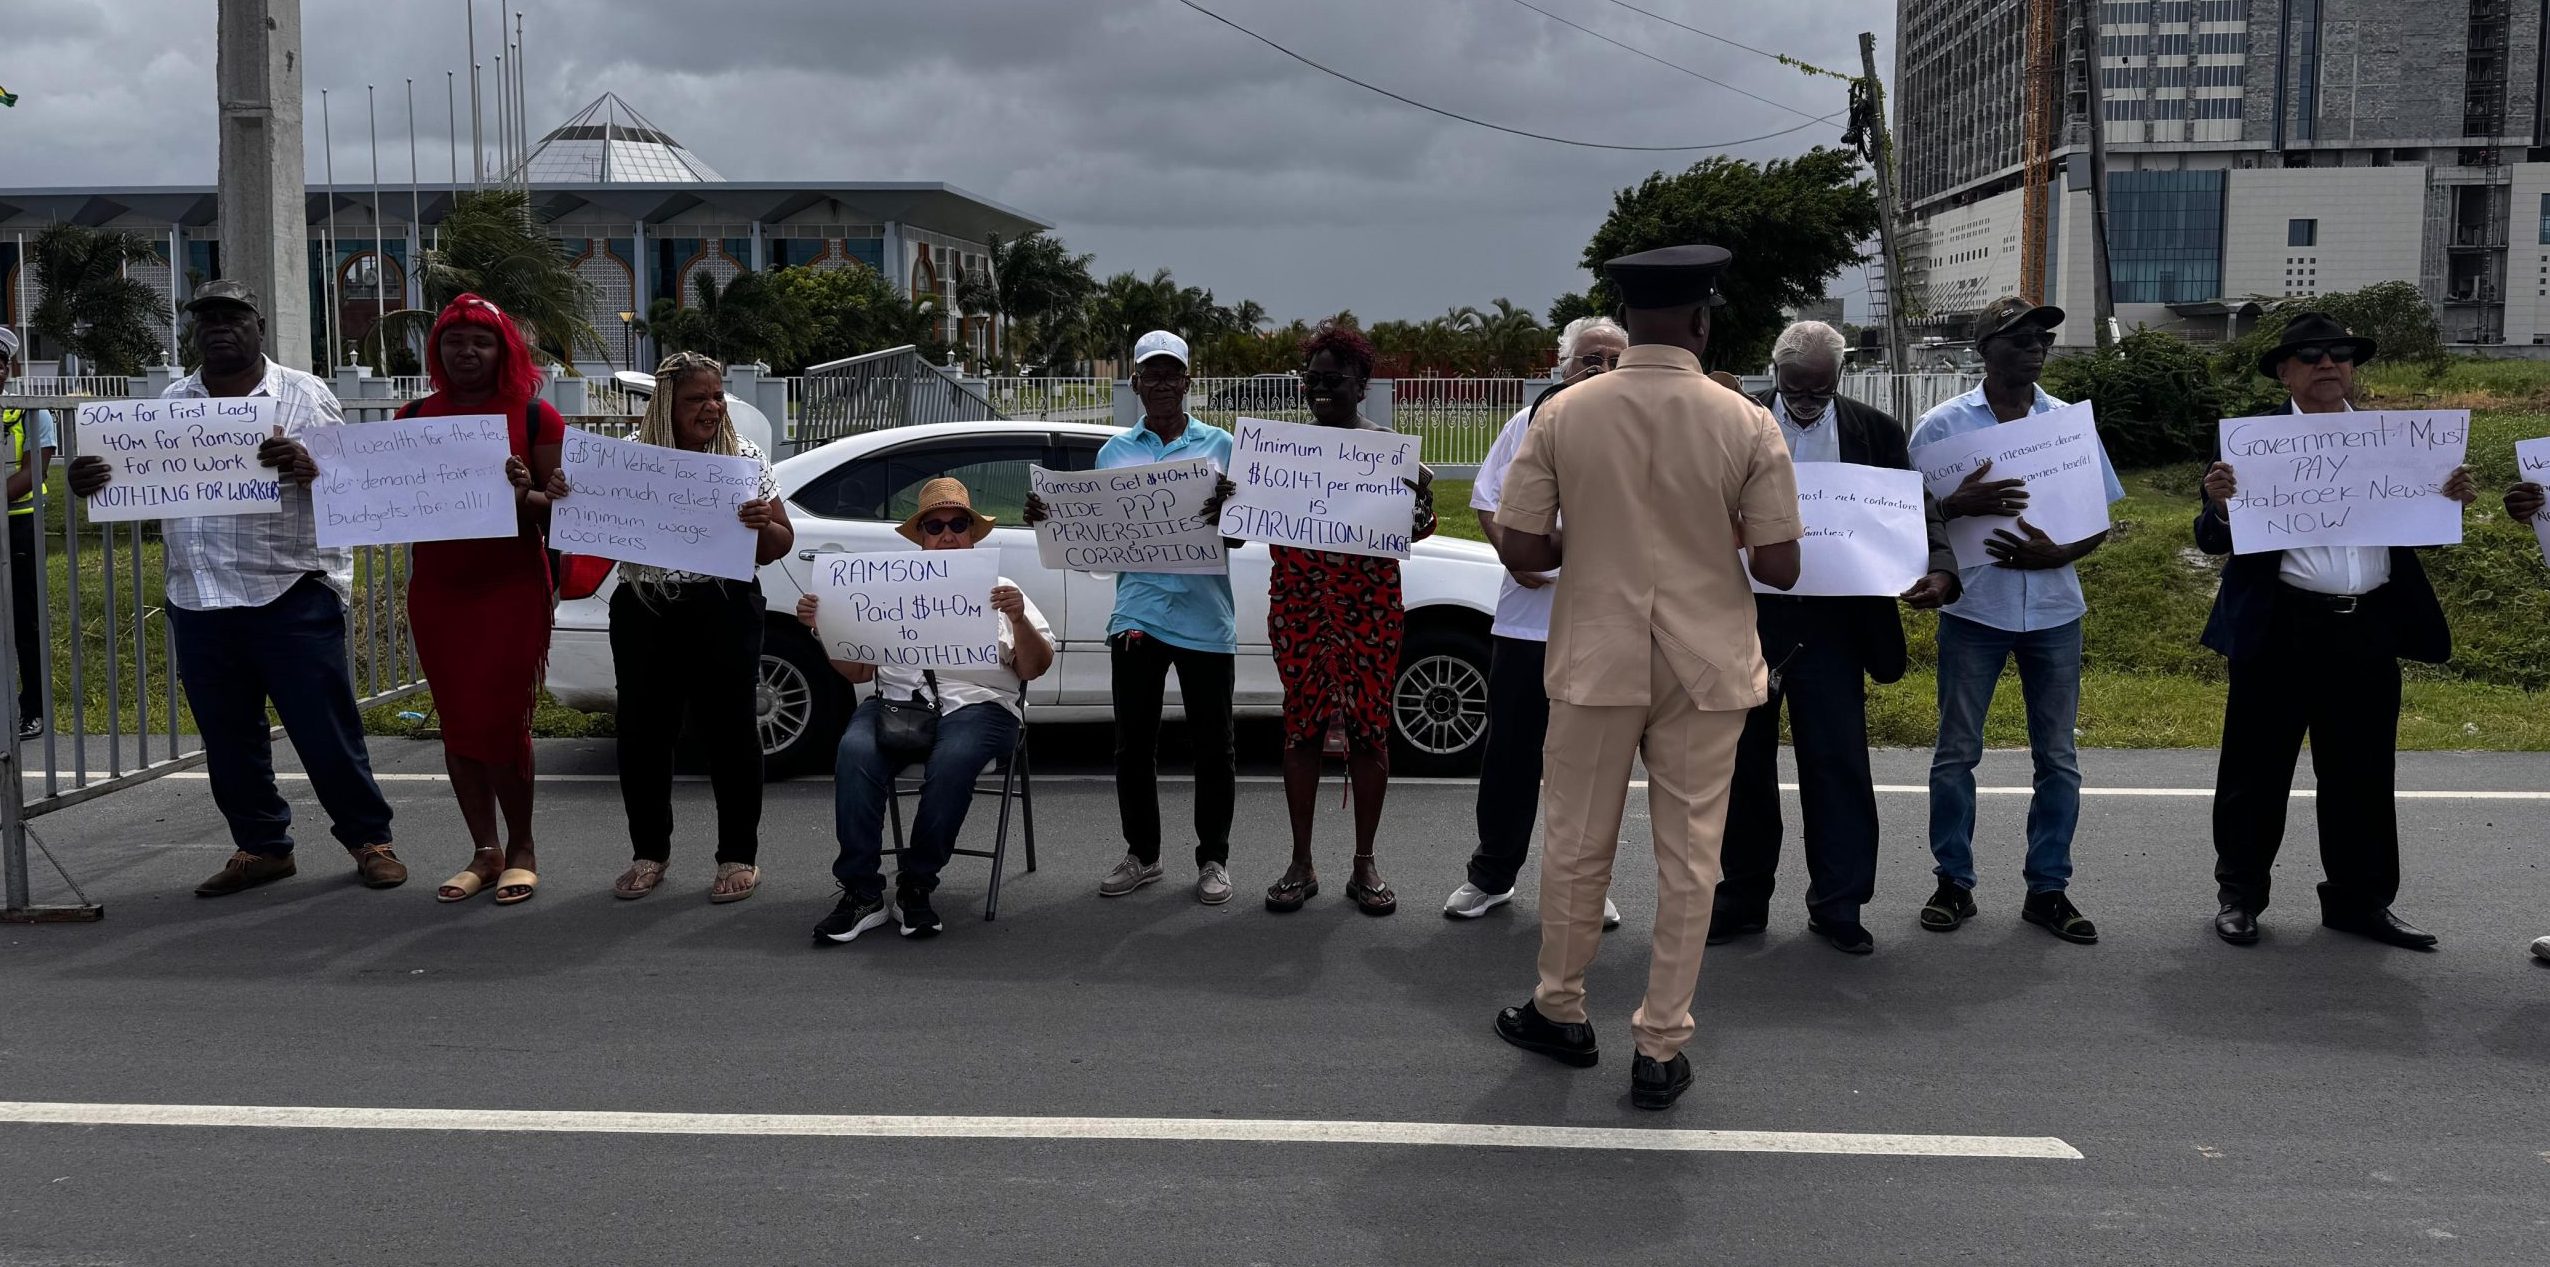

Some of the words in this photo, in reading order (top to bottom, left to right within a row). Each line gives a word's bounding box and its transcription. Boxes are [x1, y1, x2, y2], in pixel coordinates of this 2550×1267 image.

[135, 404, 157, 422] for
[169, 402, 206, 422] First
[217, 401, 258, 423] Lady
[154, 430, 182, 450] for
[187, 424, 265, 450] Ramson
[312, 431, 346, 461] Oil
[354, 428, 418, 455] wealth
[422, 425, 443, 447] for
[450, 423, 475, 442] the
[1240, 426, 1322, 457] Minimum
[1391, 443, 1410, 466] of
[2227, 415, 2388, 456] Government
[2411, 416, 2467, 450] Must
[1999, 440, 2051, 461] measures
[162, 457, 187, 473] no
[622, 450, 667, 475] Vehicle
[669, 457, 697, 481] Tax
[1032, 470, 1101, 495] Ramson
[1110, 473, 1141, 492] Get
[1191, 462, 1209, 479] to
[2289, 454, 2348, 482] PAY
[321, 468, 345, 496] We
[361, 468, 426, 491] demand
[439, 463, 470, 485] fair
[1327, 481, 1350, 499] per
[1356, 477, 1408, 496] month
[2369, 475, 2443, 500] News
[89, 483, 189, 511] NOTHING
[196, 480, 223, 500] FOR
[611, 481, 658, 504] much
[668, 490, 720, 511] relief
[1309, 498, 1327, 515] is
[327, 503, 408, 532] budgets
[414, 490, 442, 516] for
[558, 505, 645, 528] minimum
[657, 521, 711, 545] wage
[1047, 503, 1103, 519] HIDE
[1221, 505, 1363, 545] STARVATION
[2267, 507, 2351, 534] NOW
[560, 529, 647, 550] workers
[1044, 515, 1206, 543] PERVERSITIES
[1065, 544, 1218, 567] CORRUPTION
[829, 558, 948, 587] RAMSON
[849, 592, 904, 622] Paid
[898, 625, 918, 640] to
[837, 641, 875, 662] DO
[884, 645, 998, 666] NOTHING
